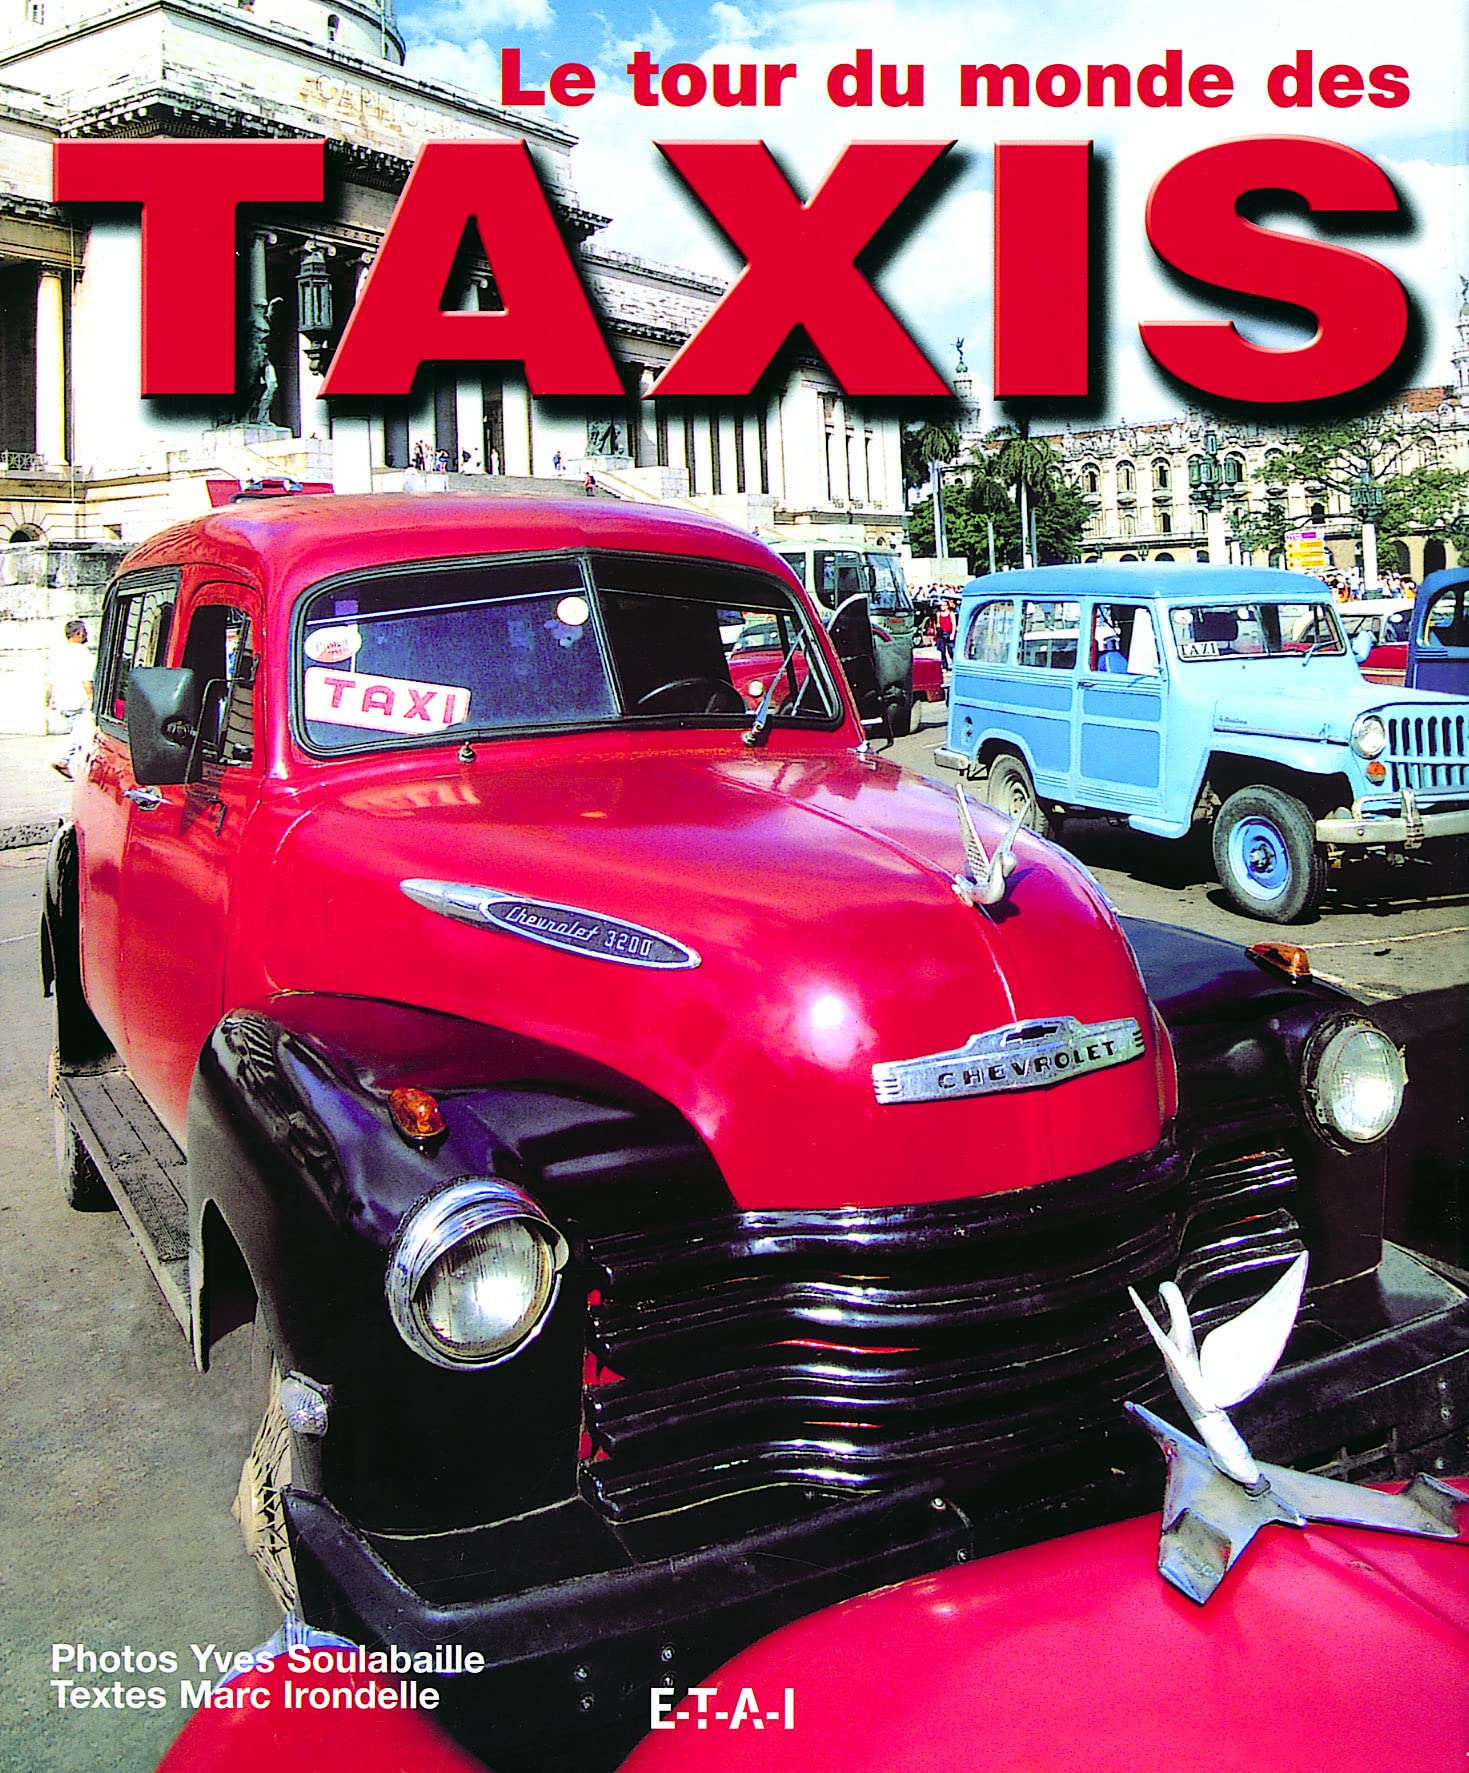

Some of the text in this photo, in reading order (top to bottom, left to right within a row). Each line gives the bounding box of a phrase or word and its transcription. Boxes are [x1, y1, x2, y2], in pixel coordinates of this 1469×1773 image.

[324, 677, 457, 725] TAXI
[505, 906, 653, 957] Chevrolet 3200
[937, 1040, 1115, 1089] CHEVROLET
